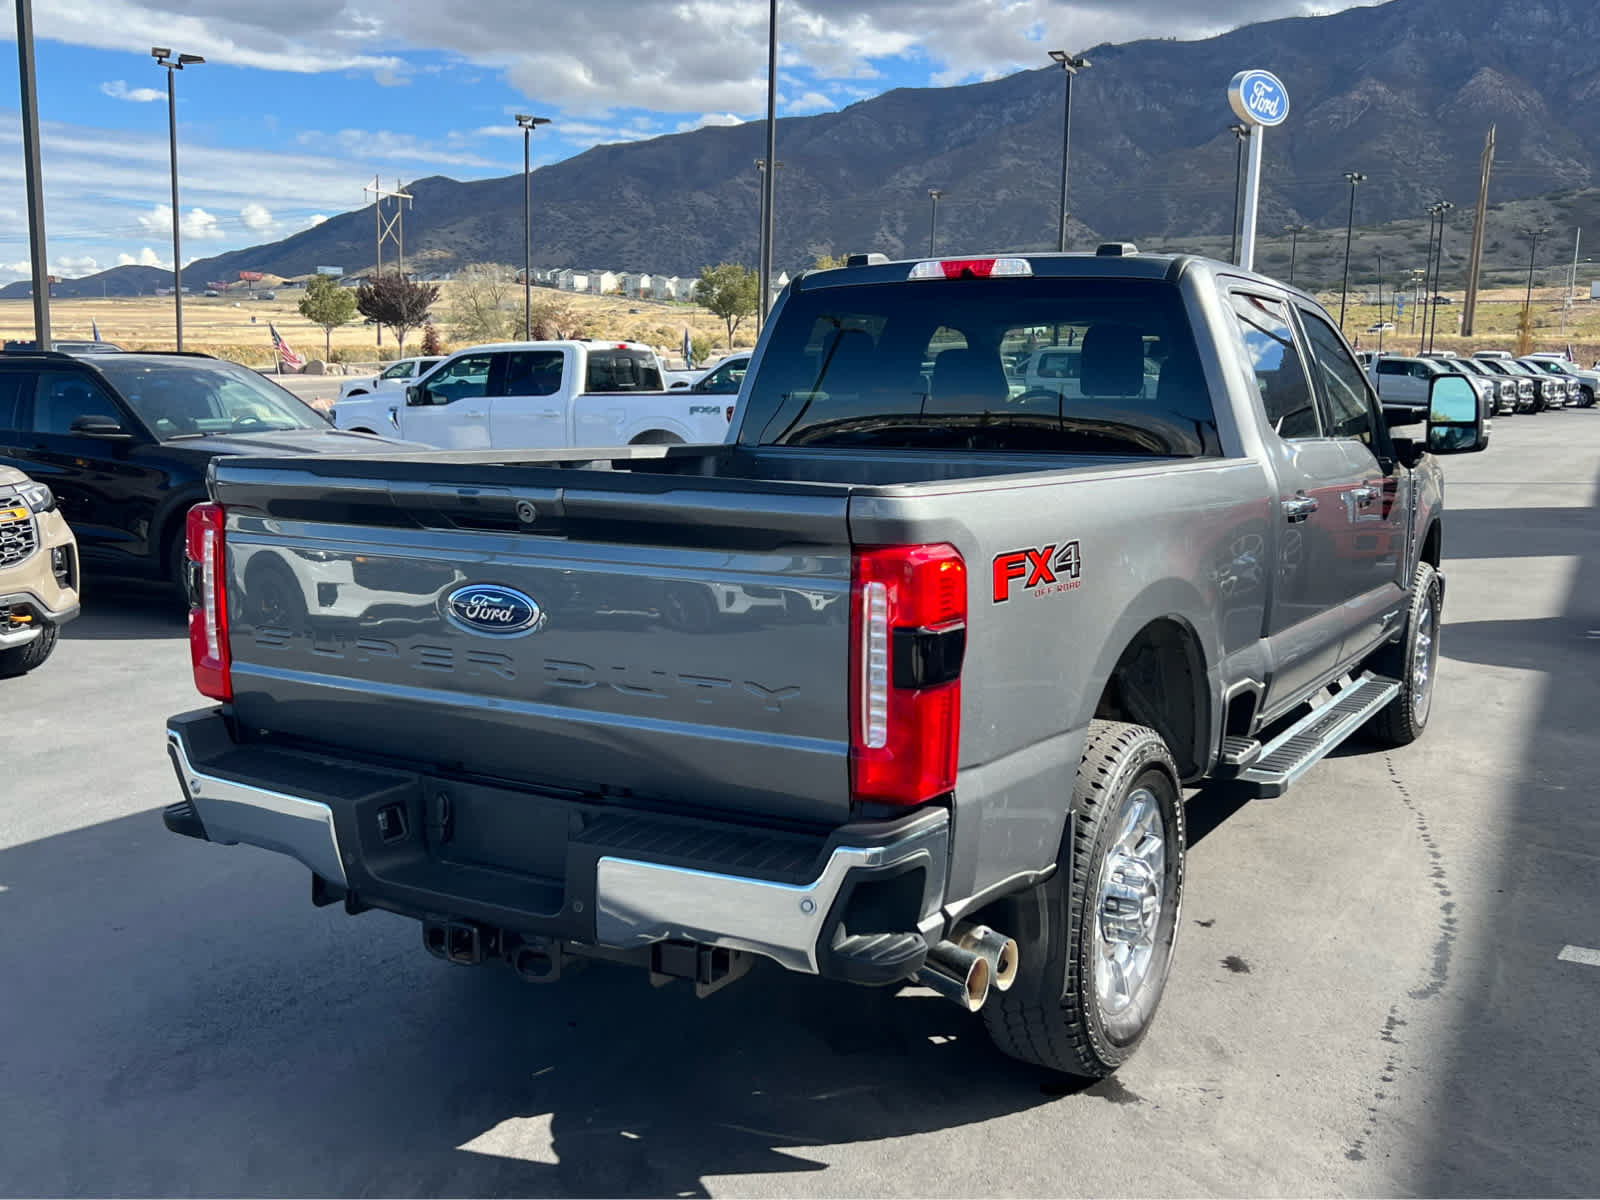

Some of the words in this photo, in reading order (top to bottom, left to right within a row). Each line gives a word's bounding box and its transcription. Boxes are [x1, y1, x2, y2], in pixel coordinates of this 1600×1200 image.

[1250, 80, 1280, 117] Ford
[992, 539, 1081, 605] FX4
[1034, 586, 1054, 599] OFF
[1056, 579, 1081, 594] ROAD
[454, 594, 516, 622] Ford
[255, 624, 516, 680] SUPER
[543, 658, 801, 712] DUTY
